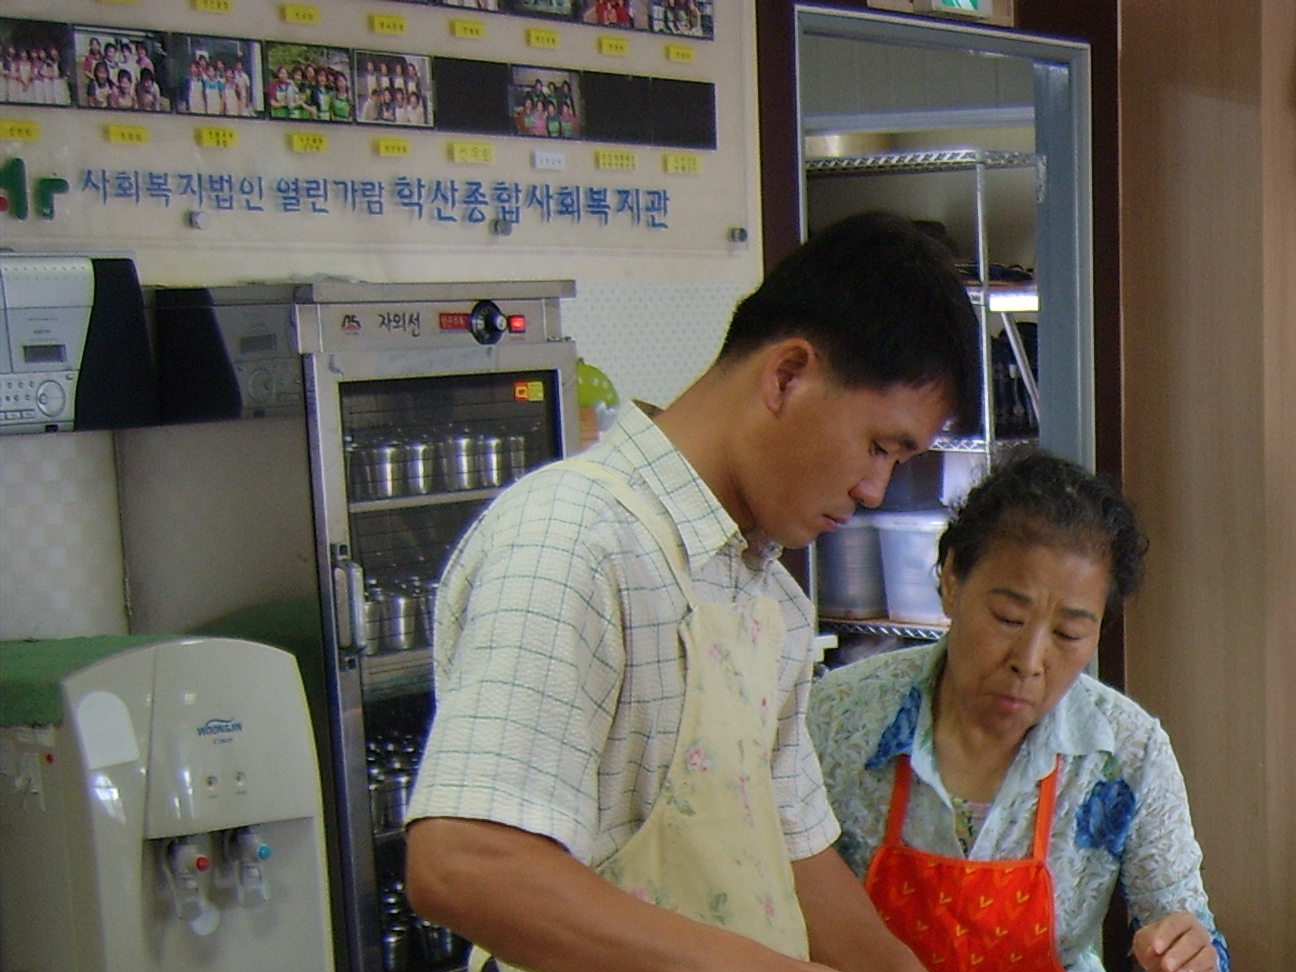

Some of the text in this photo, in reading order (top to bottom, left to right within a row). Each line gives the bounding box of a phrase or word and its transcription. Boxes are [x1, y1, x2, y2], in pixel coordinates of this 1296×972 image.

[82, 168, 264, 211] 사회복지법인
[277, 177, 385, 216] 열린가람
[394, 175, 671, 230] 학산종합사회복지관
